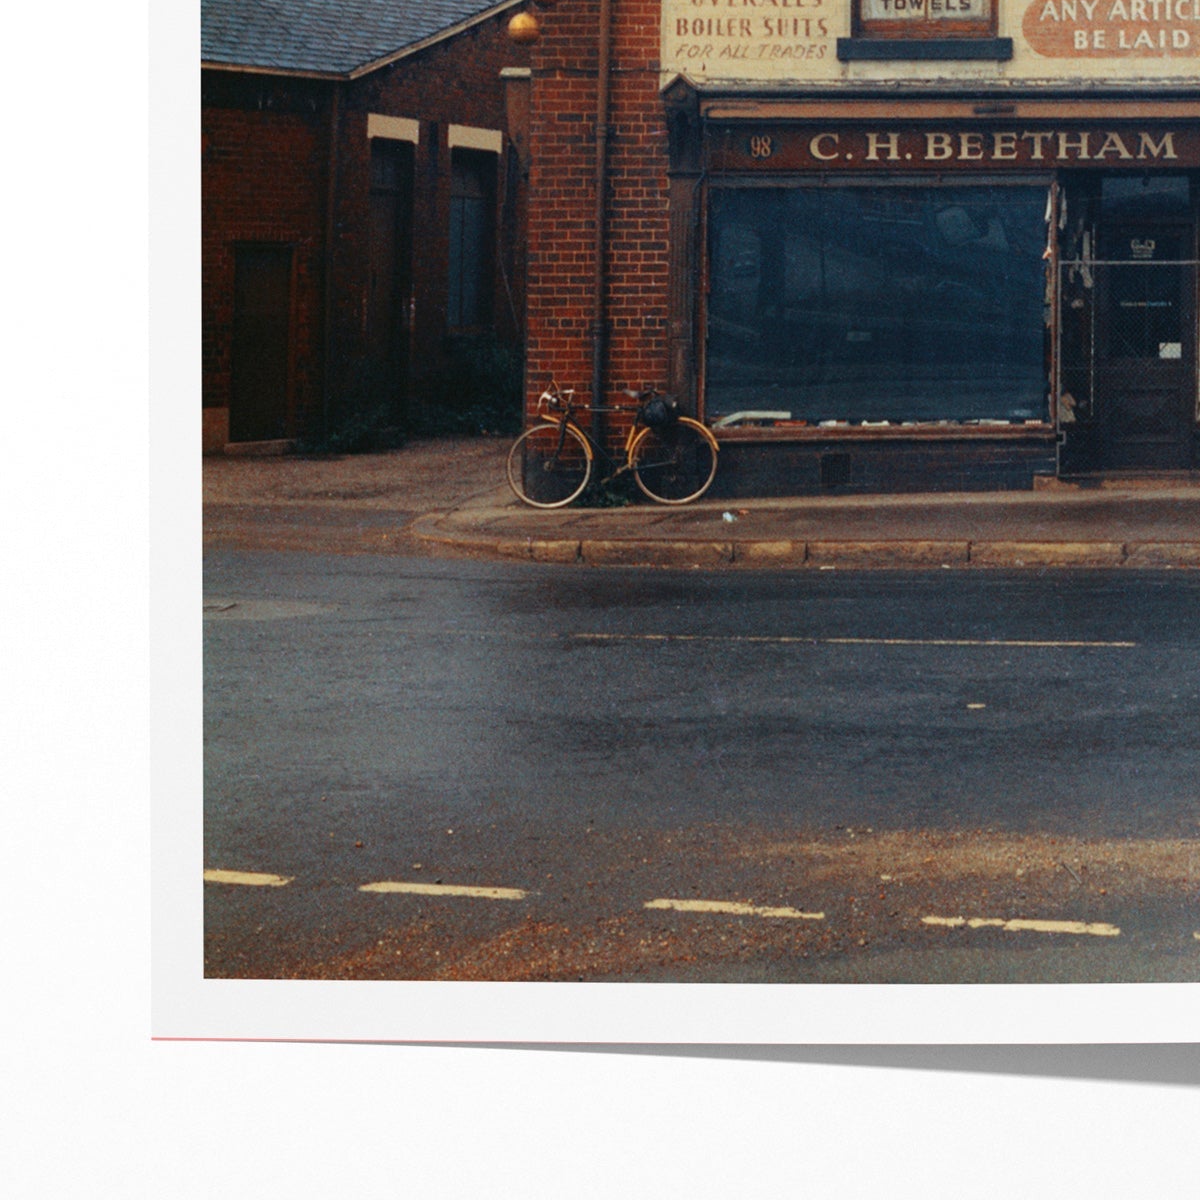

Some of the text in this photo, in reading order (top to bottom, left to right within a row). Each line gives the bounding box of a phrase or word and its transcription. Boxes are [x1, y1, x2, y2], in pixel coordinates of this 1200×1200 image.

[1040, 0, 1098, 22] ANY
[676, 17, 828, 37] BOILER SUITS
[1073, 30, 1105, 50] BE
[1118, 30, 1191, 49] LAID
[675, 43, 828, 60] FOR ALL TRADES
[751, 136, 771, 158] 98
